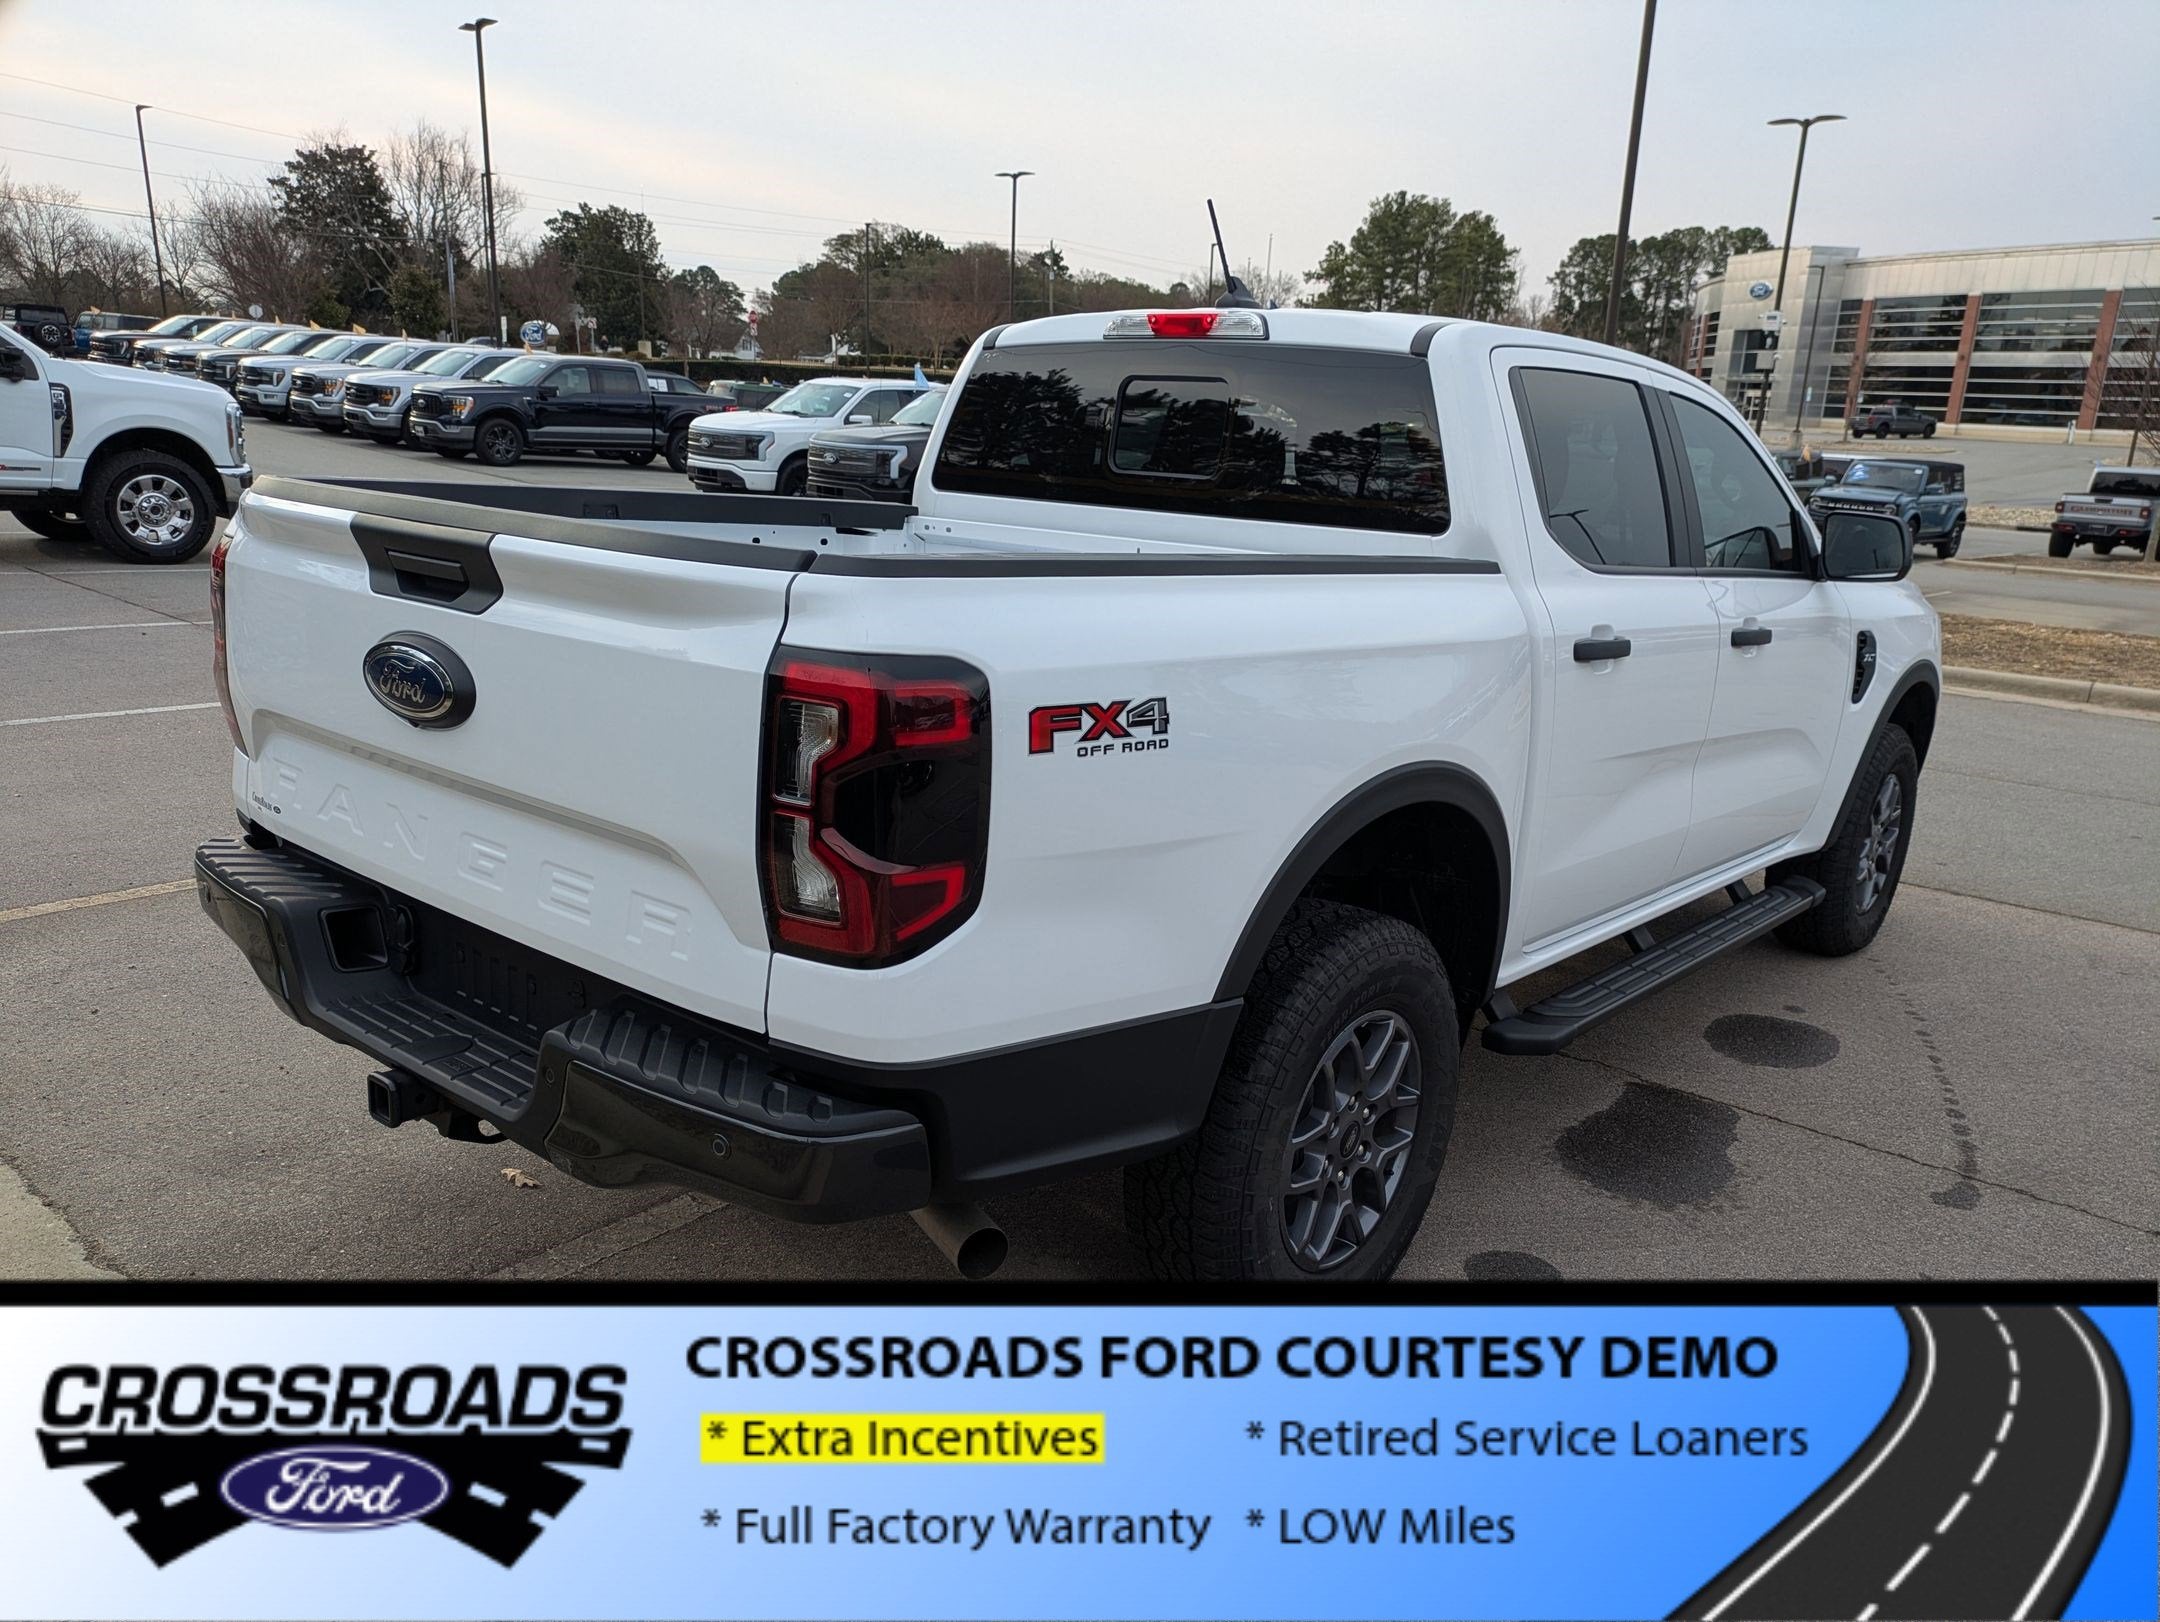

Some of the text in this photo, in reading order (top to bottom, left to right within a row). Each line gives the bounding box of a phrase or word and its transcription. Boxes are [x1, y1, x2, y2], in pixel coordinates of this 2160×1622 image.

[379, 658, 427, 704] Ford
[1028, 696, 1170, 755] FX4
[1077, 738, 1169, 758] OFF ROAD
[271, 756, 694, 962] RANGER
